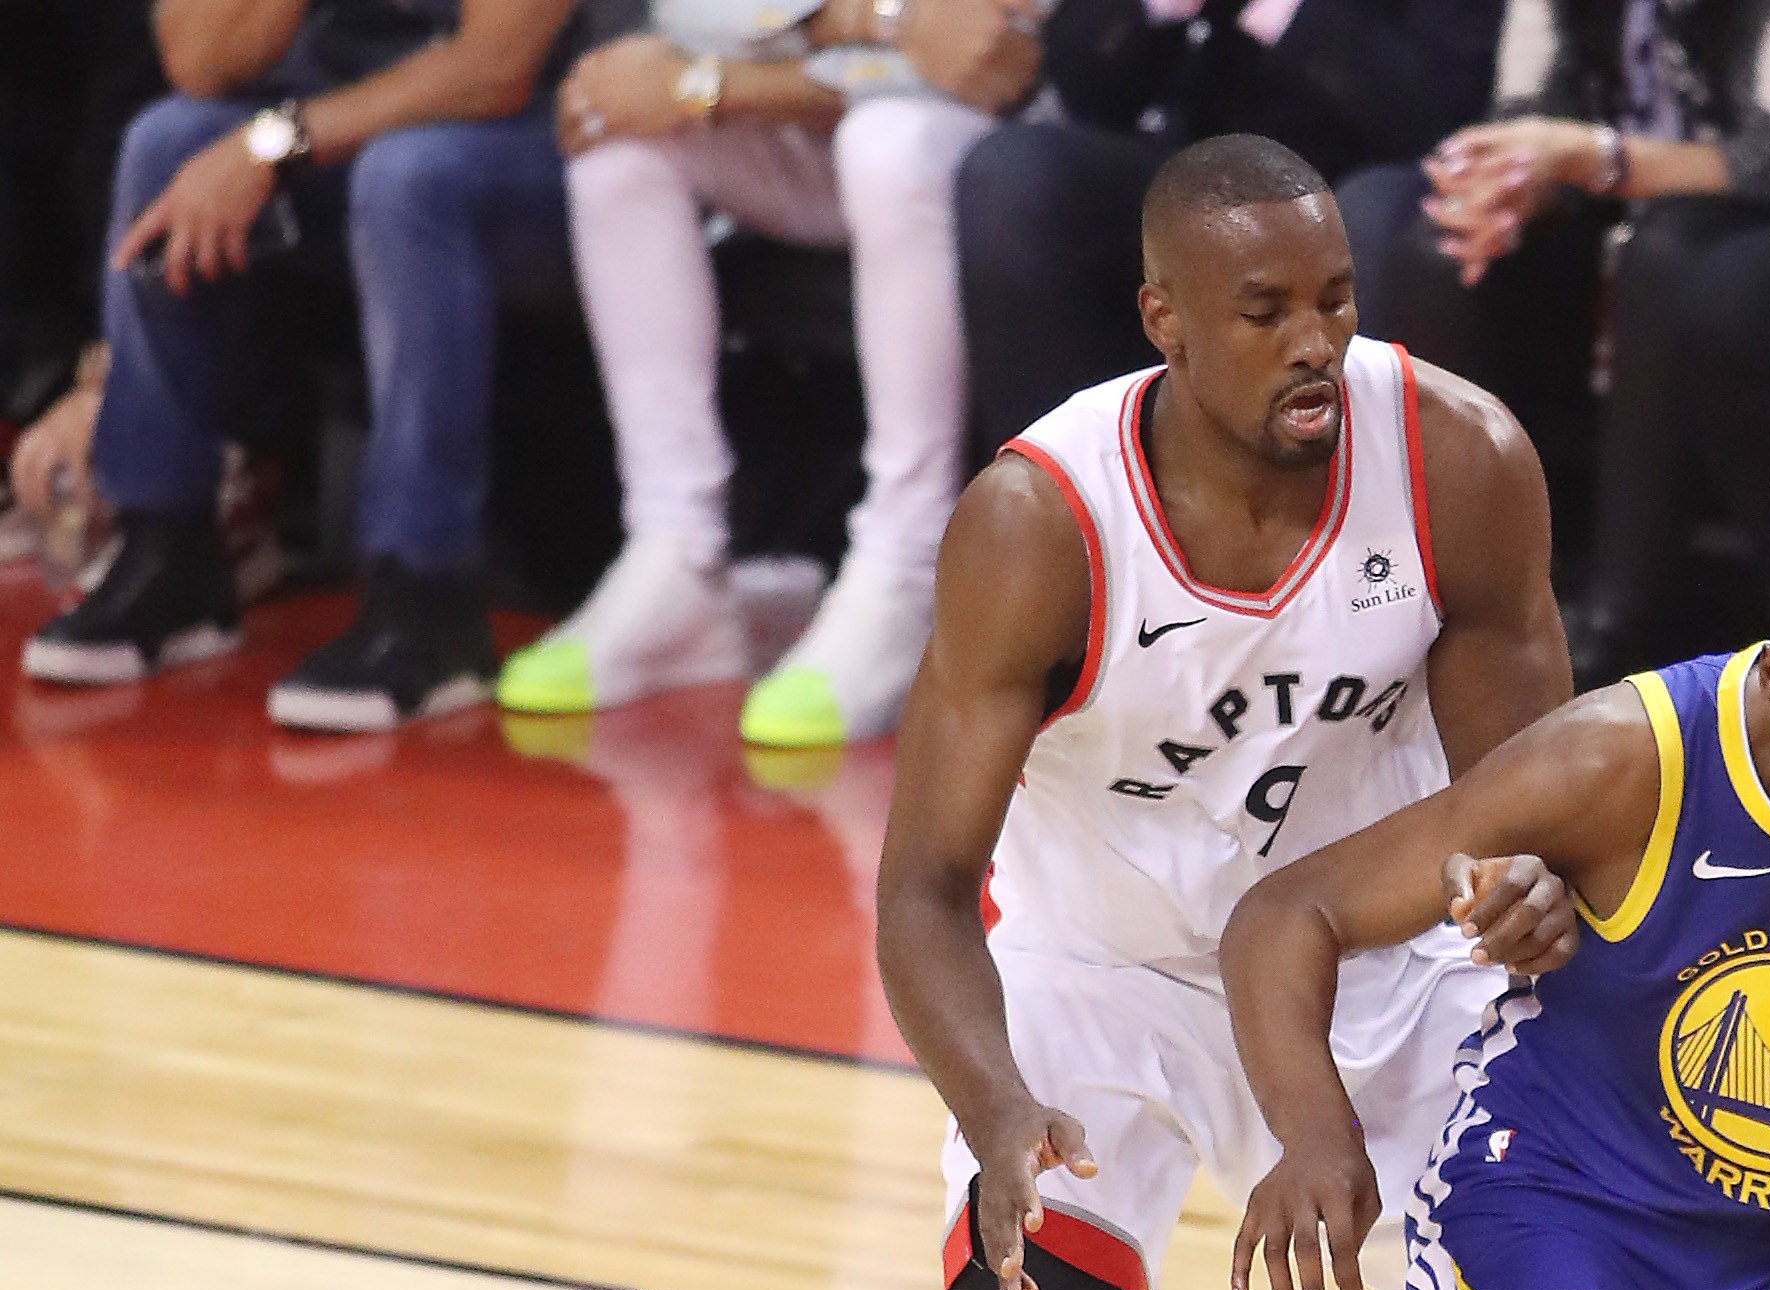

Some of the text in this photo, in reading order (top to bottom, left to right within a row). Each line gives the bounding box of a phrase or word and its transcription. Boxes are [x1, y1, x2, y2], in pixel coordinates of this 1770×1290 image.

[1351, 584, 1417, 613] Sun Life
[1245, 765, 1307, 857] 9
